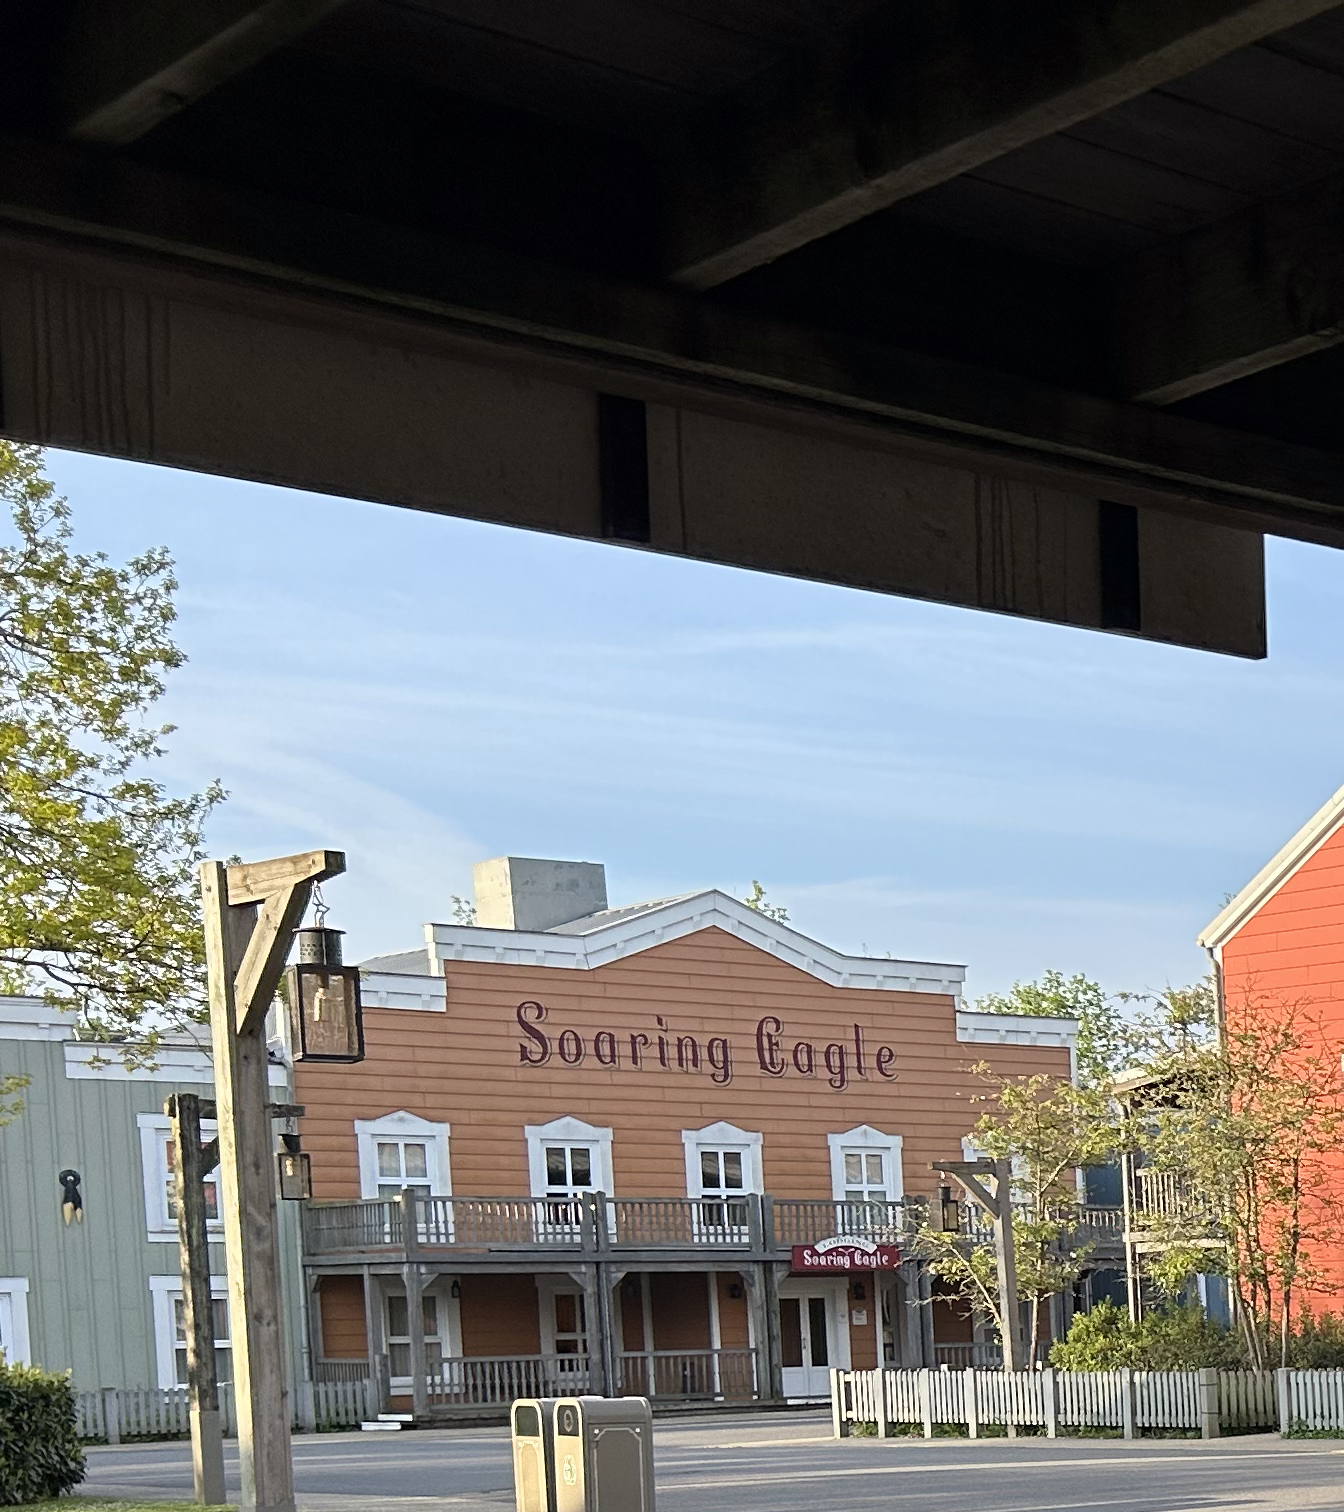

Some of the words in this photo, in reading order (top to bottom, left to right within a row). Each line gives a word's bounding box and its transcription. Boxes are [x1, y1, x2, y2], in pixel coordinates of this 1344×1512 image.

[516, 1000, 733, 1087] Soaring
[756, 1015, 899, 1092] Eagle
[803, 1249, 851, 1269] Soaring
[854, 1249, 889, 1268] Eagle
